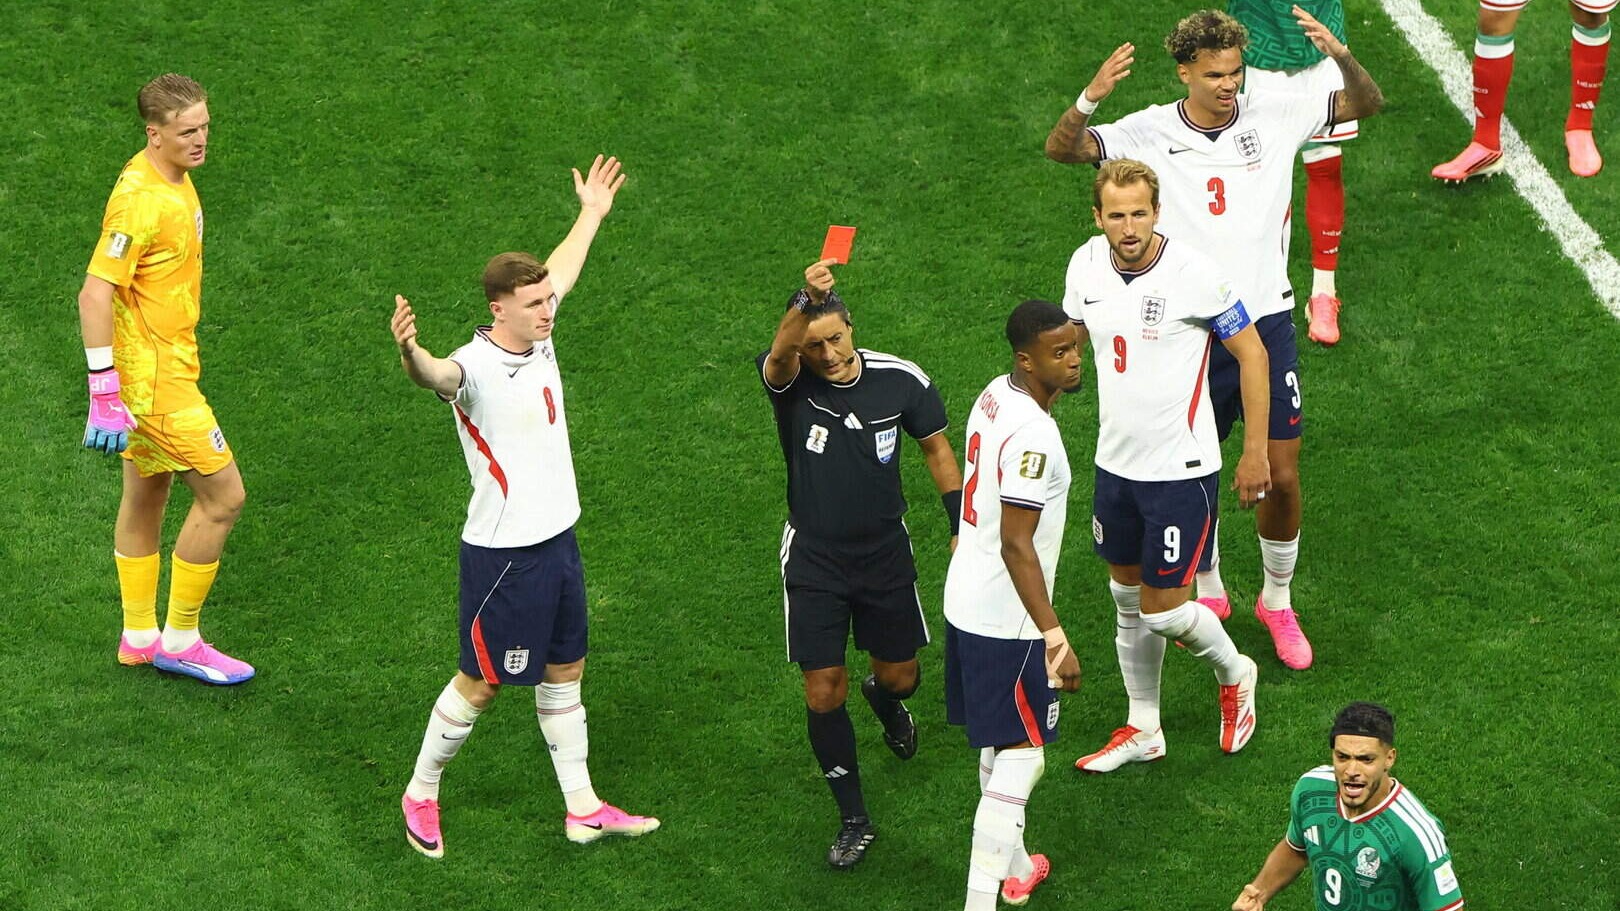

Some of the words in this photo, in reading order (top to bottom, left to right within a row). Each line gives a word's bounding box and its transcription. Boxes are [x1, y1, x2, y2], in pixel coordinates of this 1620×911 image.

[1207, 177, 1226, 215] 3
[1217, 310, 1240, 328] UNITES
[1113, 335, 1127, 374] 9
[543, 386, 556, 425] 8
[1285, 370, 1301, 409] 3
[878, 430, 896, 443] FIFA
[963, 431, 981, 527] 2
[1164, 525, 1181, 563] 9
[1324, 868, 1342, 906] 9
